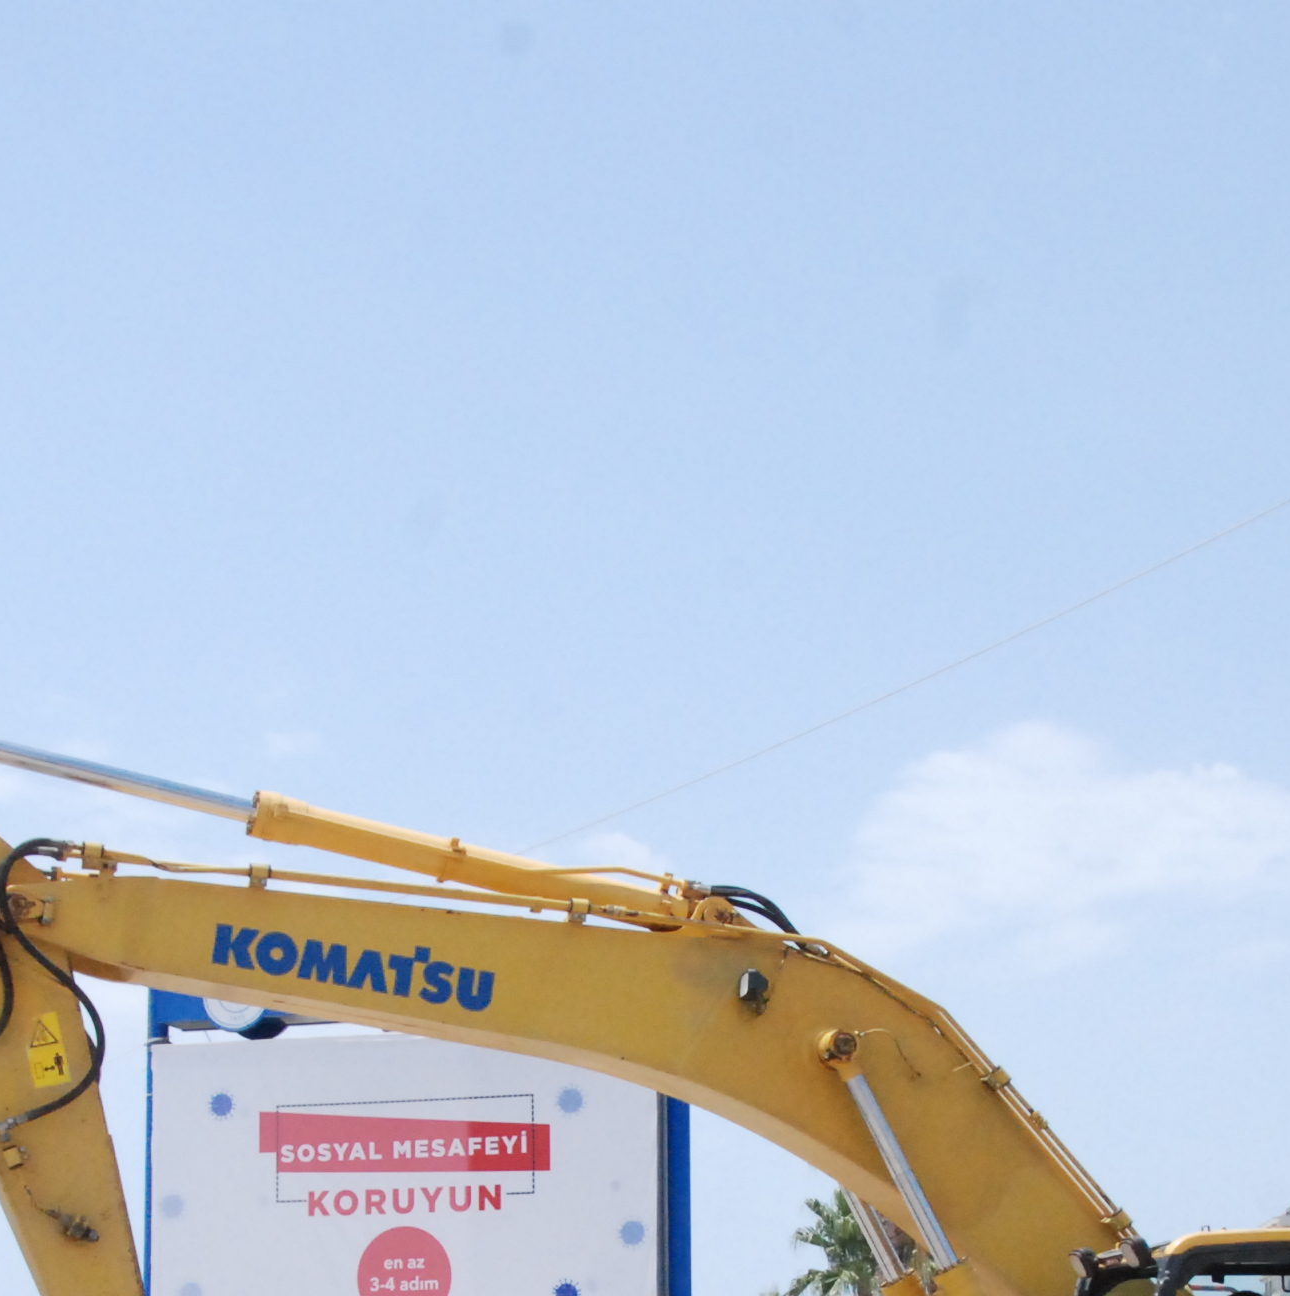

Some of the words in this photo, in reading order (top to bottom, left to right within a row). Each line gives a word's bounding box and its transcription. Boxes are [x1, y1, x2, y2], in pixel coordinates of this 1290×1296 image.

[211, 923, 495, 1012] KOMATSU
[280, 1141, 383, 1163] SOSYAL
[392, 1130, 528, 1159] MESAFEYİ
[307, 1184, 502, 1216] KORUYUN
[383, 1258, 403, 1270] en
[407, 1256, 426, 1269] az
[369, 1276, 395, 1292] 3-4
[399, 1275, 439, 1291] adım
